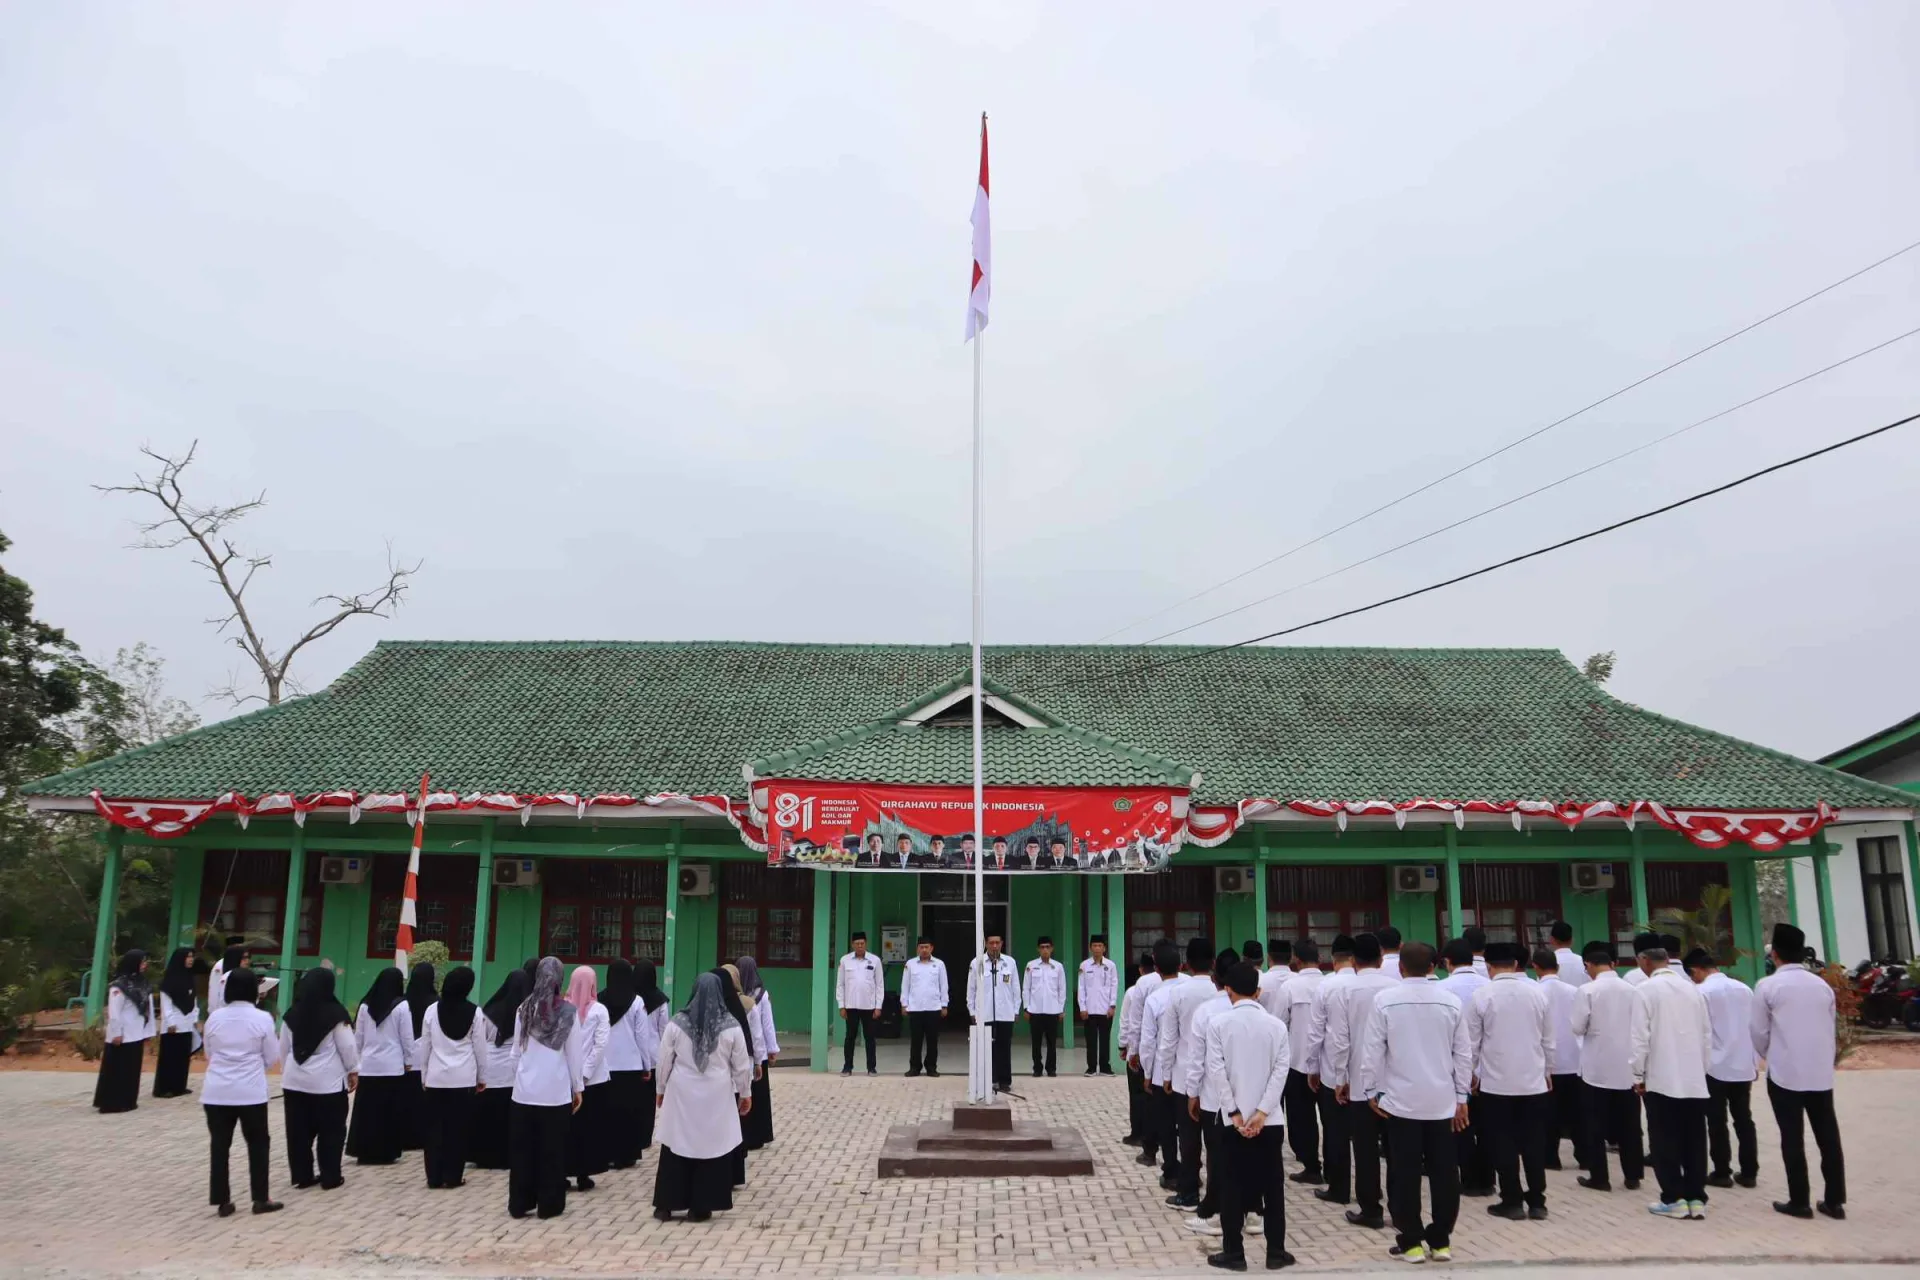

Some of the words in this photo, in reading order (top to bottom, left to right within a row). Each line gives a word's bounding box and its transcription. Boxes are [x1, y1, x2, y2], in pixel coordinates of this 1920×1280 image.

[775, 792, 817, 832] 81
[881, 800, 937, 809] DIRGAHAYU
[941, 801, 989, 810] REPUBK
[992, 802, 1045, 811] INDONESIA
